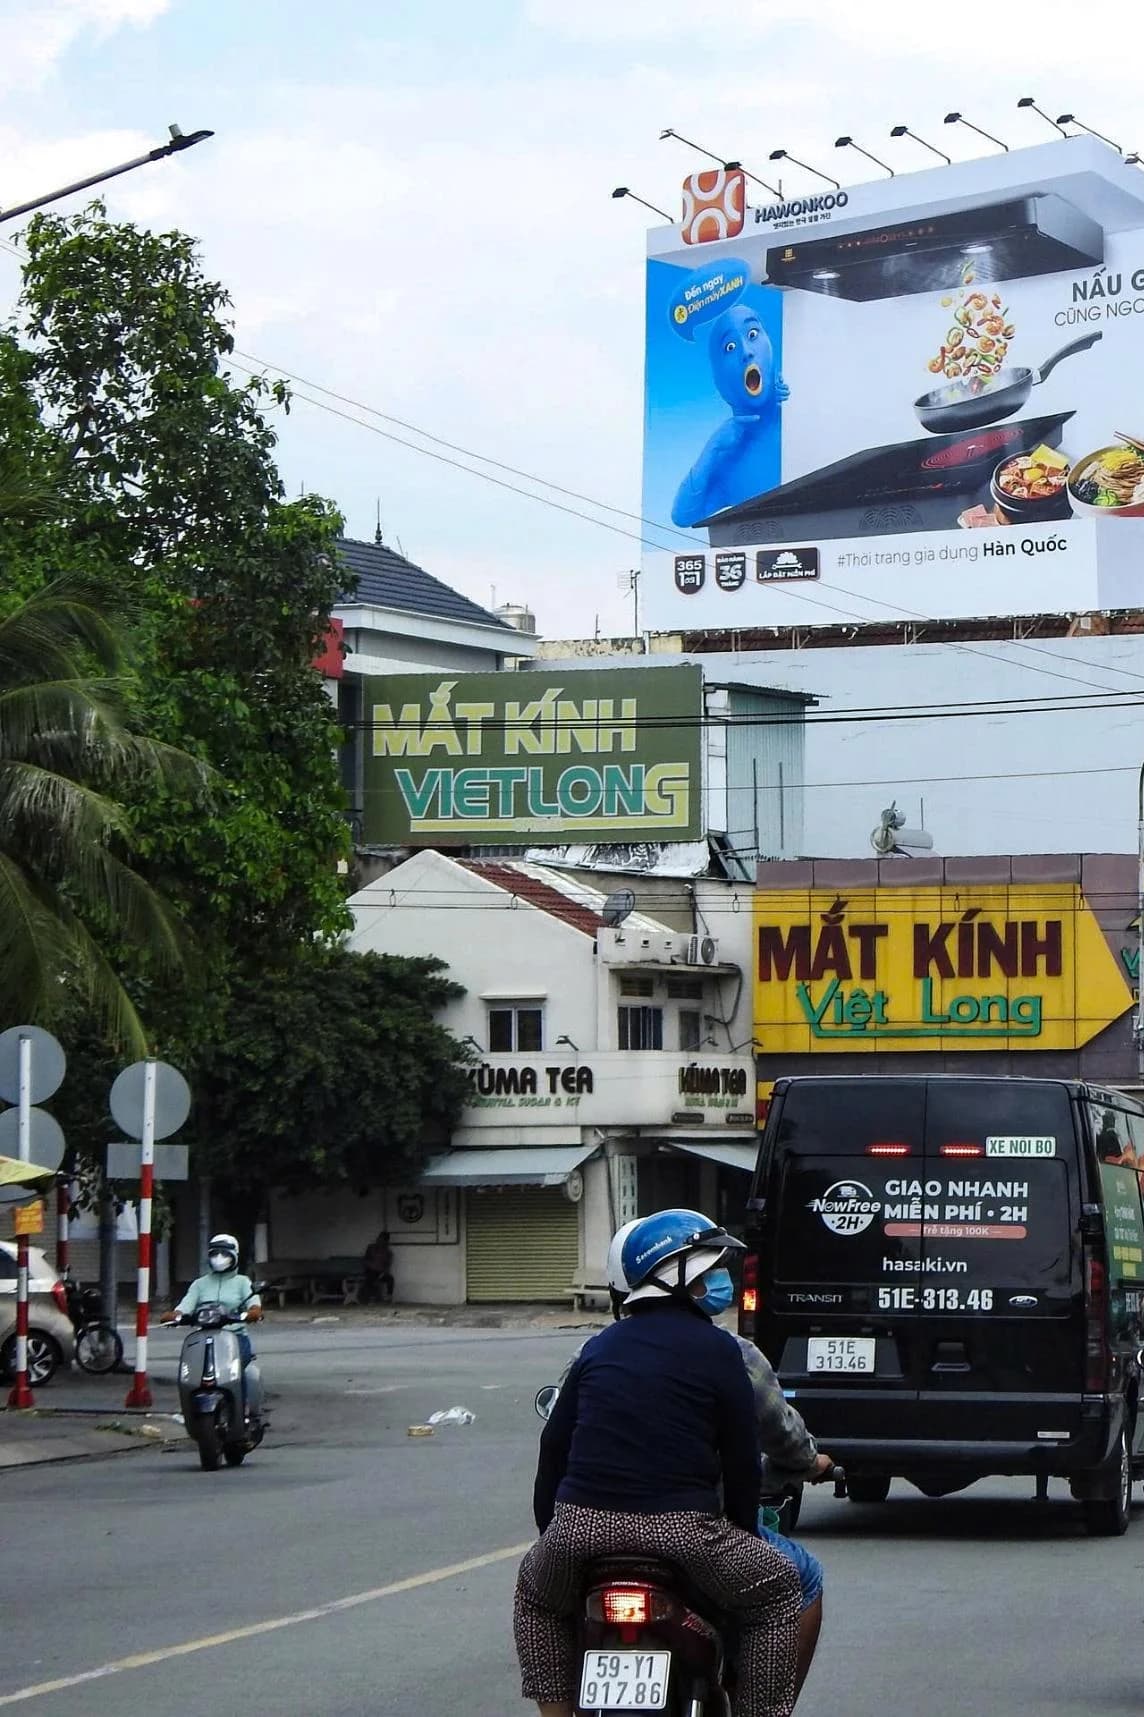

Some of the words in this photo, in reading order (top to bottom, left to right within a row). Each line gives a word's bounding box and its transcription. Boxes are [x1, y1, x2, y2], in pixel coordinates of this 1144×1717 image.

[755, 191, 849, 223] HAWONKOO
[685, 285, 702, 301] Đến
[702, 273, 723, 291] ngay
[1073, 267, 1121, 302] NẤU
[1054, 306, 1101, 326] CŨNG
[876, 551, 910, 566] trang
[914, 549, 935, 565] gia
[939, 546, 978, 561] dụng
[984, 541, 1015, 557] Hàn
[1021, 534, 1067, 554] Quốc
[677, 560, 702, 571] 365
[719, 564, 742, 580] 36
[373, 681, 495, 756] MẮT
[504, 688, 637, 754] KÍNH
[758, 900, 888, 981] MẮT
[913, 908, 1062, 978] KÍNH
[797, 978, 889, 1031] Việt
[922, 976, 1042, 1037] Long
[545, 1066, 593, 1095] TEA
[990, 1140, 1005, 1154] XE
[885, 1180, 942, 1196] GIAO
[948, 1181, 1028, 1198] NHANH
[812, 1198, 881, 1213] NowFree
[884, 1197, 939, 1220] MIỄN
[945, 1202, 983, 1221] PHÍ
[1000, 1206, 1028, 1222] 2H
[836, 1216, 860, 1231] 2H
[965, 1227, 989, 1236] 100K
[883, 1257, 967, 1272] hasaki.vn
[878, 1288, 993, 1310] 51E-313.46
[828, 1341, 855, 1354] 51E
[816, 1356, 866, 1369] 313.46
[596, 1656, 654, 1679] 59-Y1
[586, 1682, 661, 1705] 917.86
